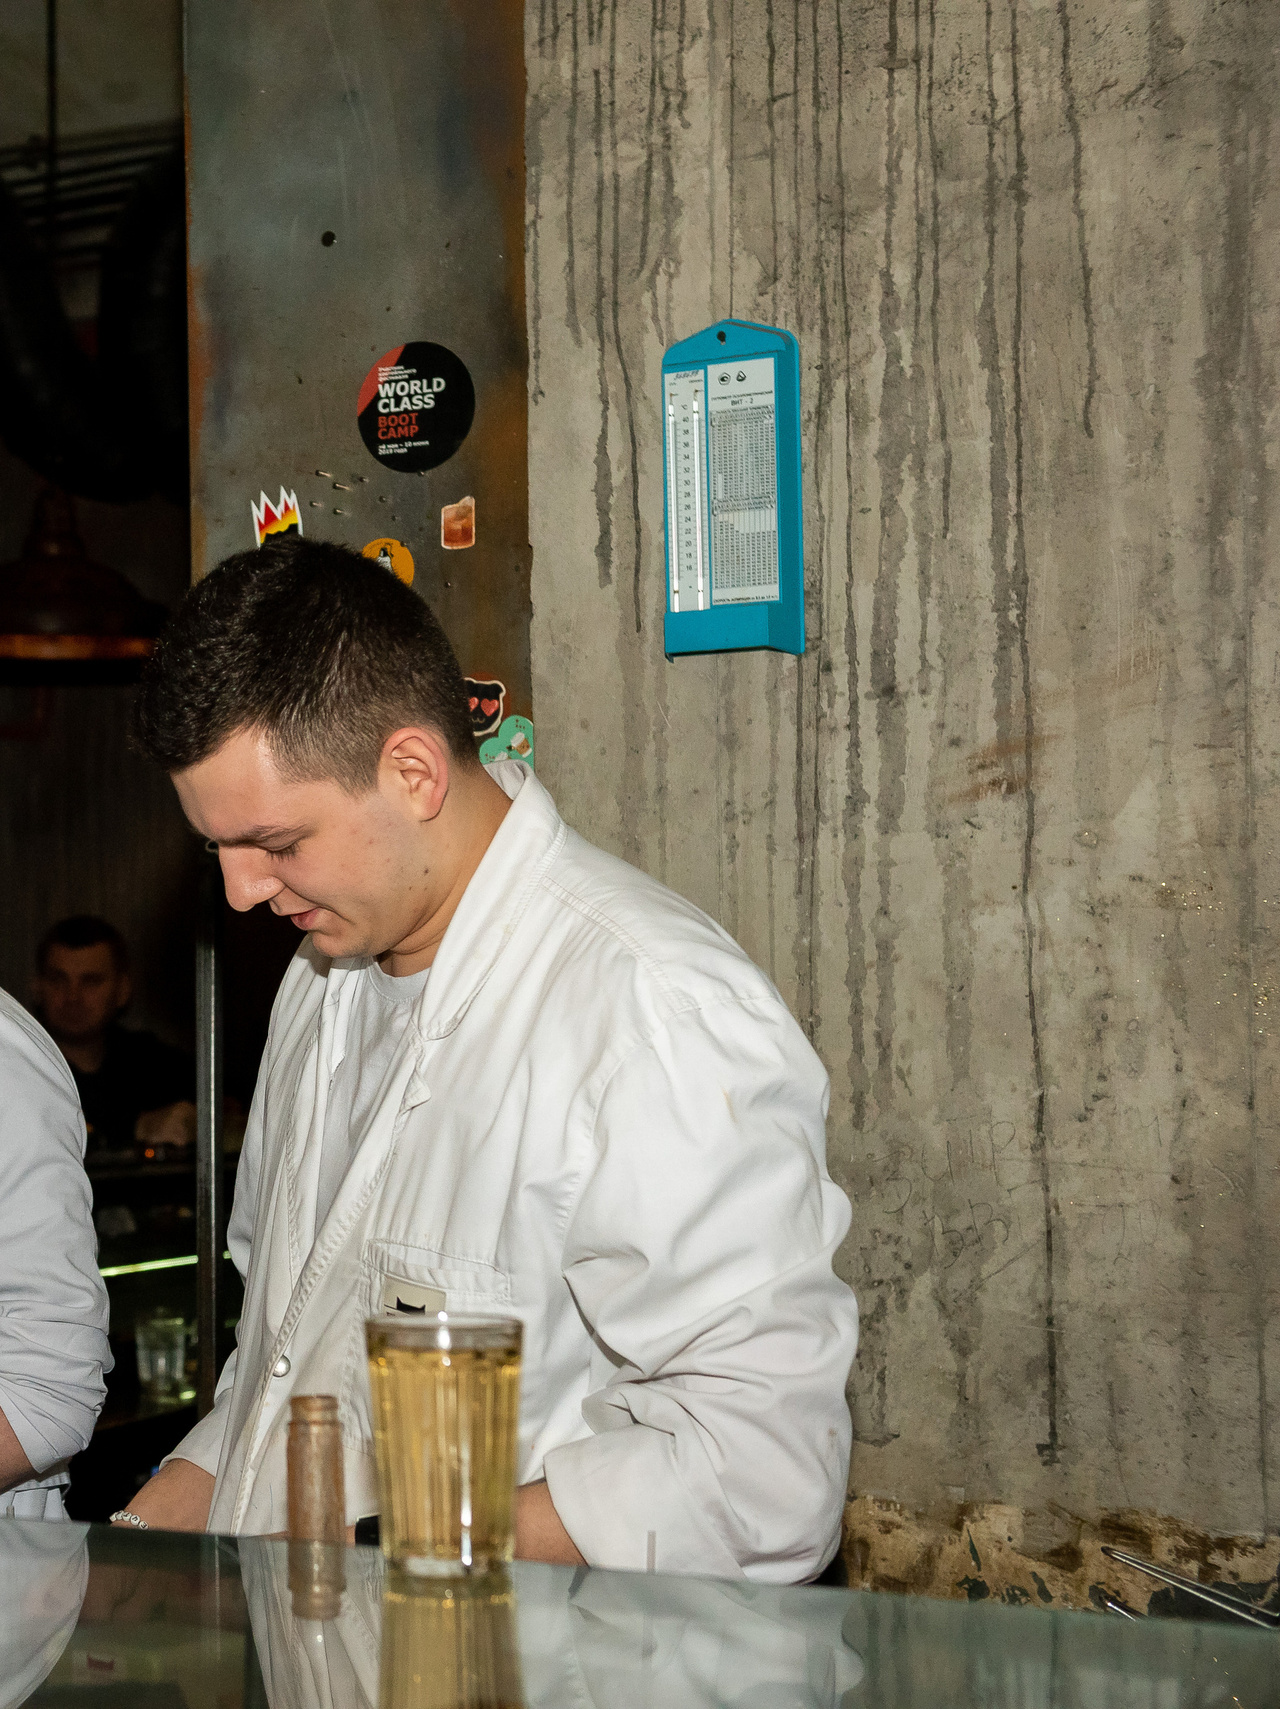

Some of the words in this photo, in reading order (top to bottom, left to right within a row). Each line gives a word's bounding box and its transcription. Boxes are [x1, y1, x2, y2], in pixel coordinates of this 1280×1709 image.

[378, 377, 446, 397] WORLD
[377, 394, 435, 414] CLASS
[378, 413, 418, 427] BOOT
[377, 425, 419, 440] CAMP
